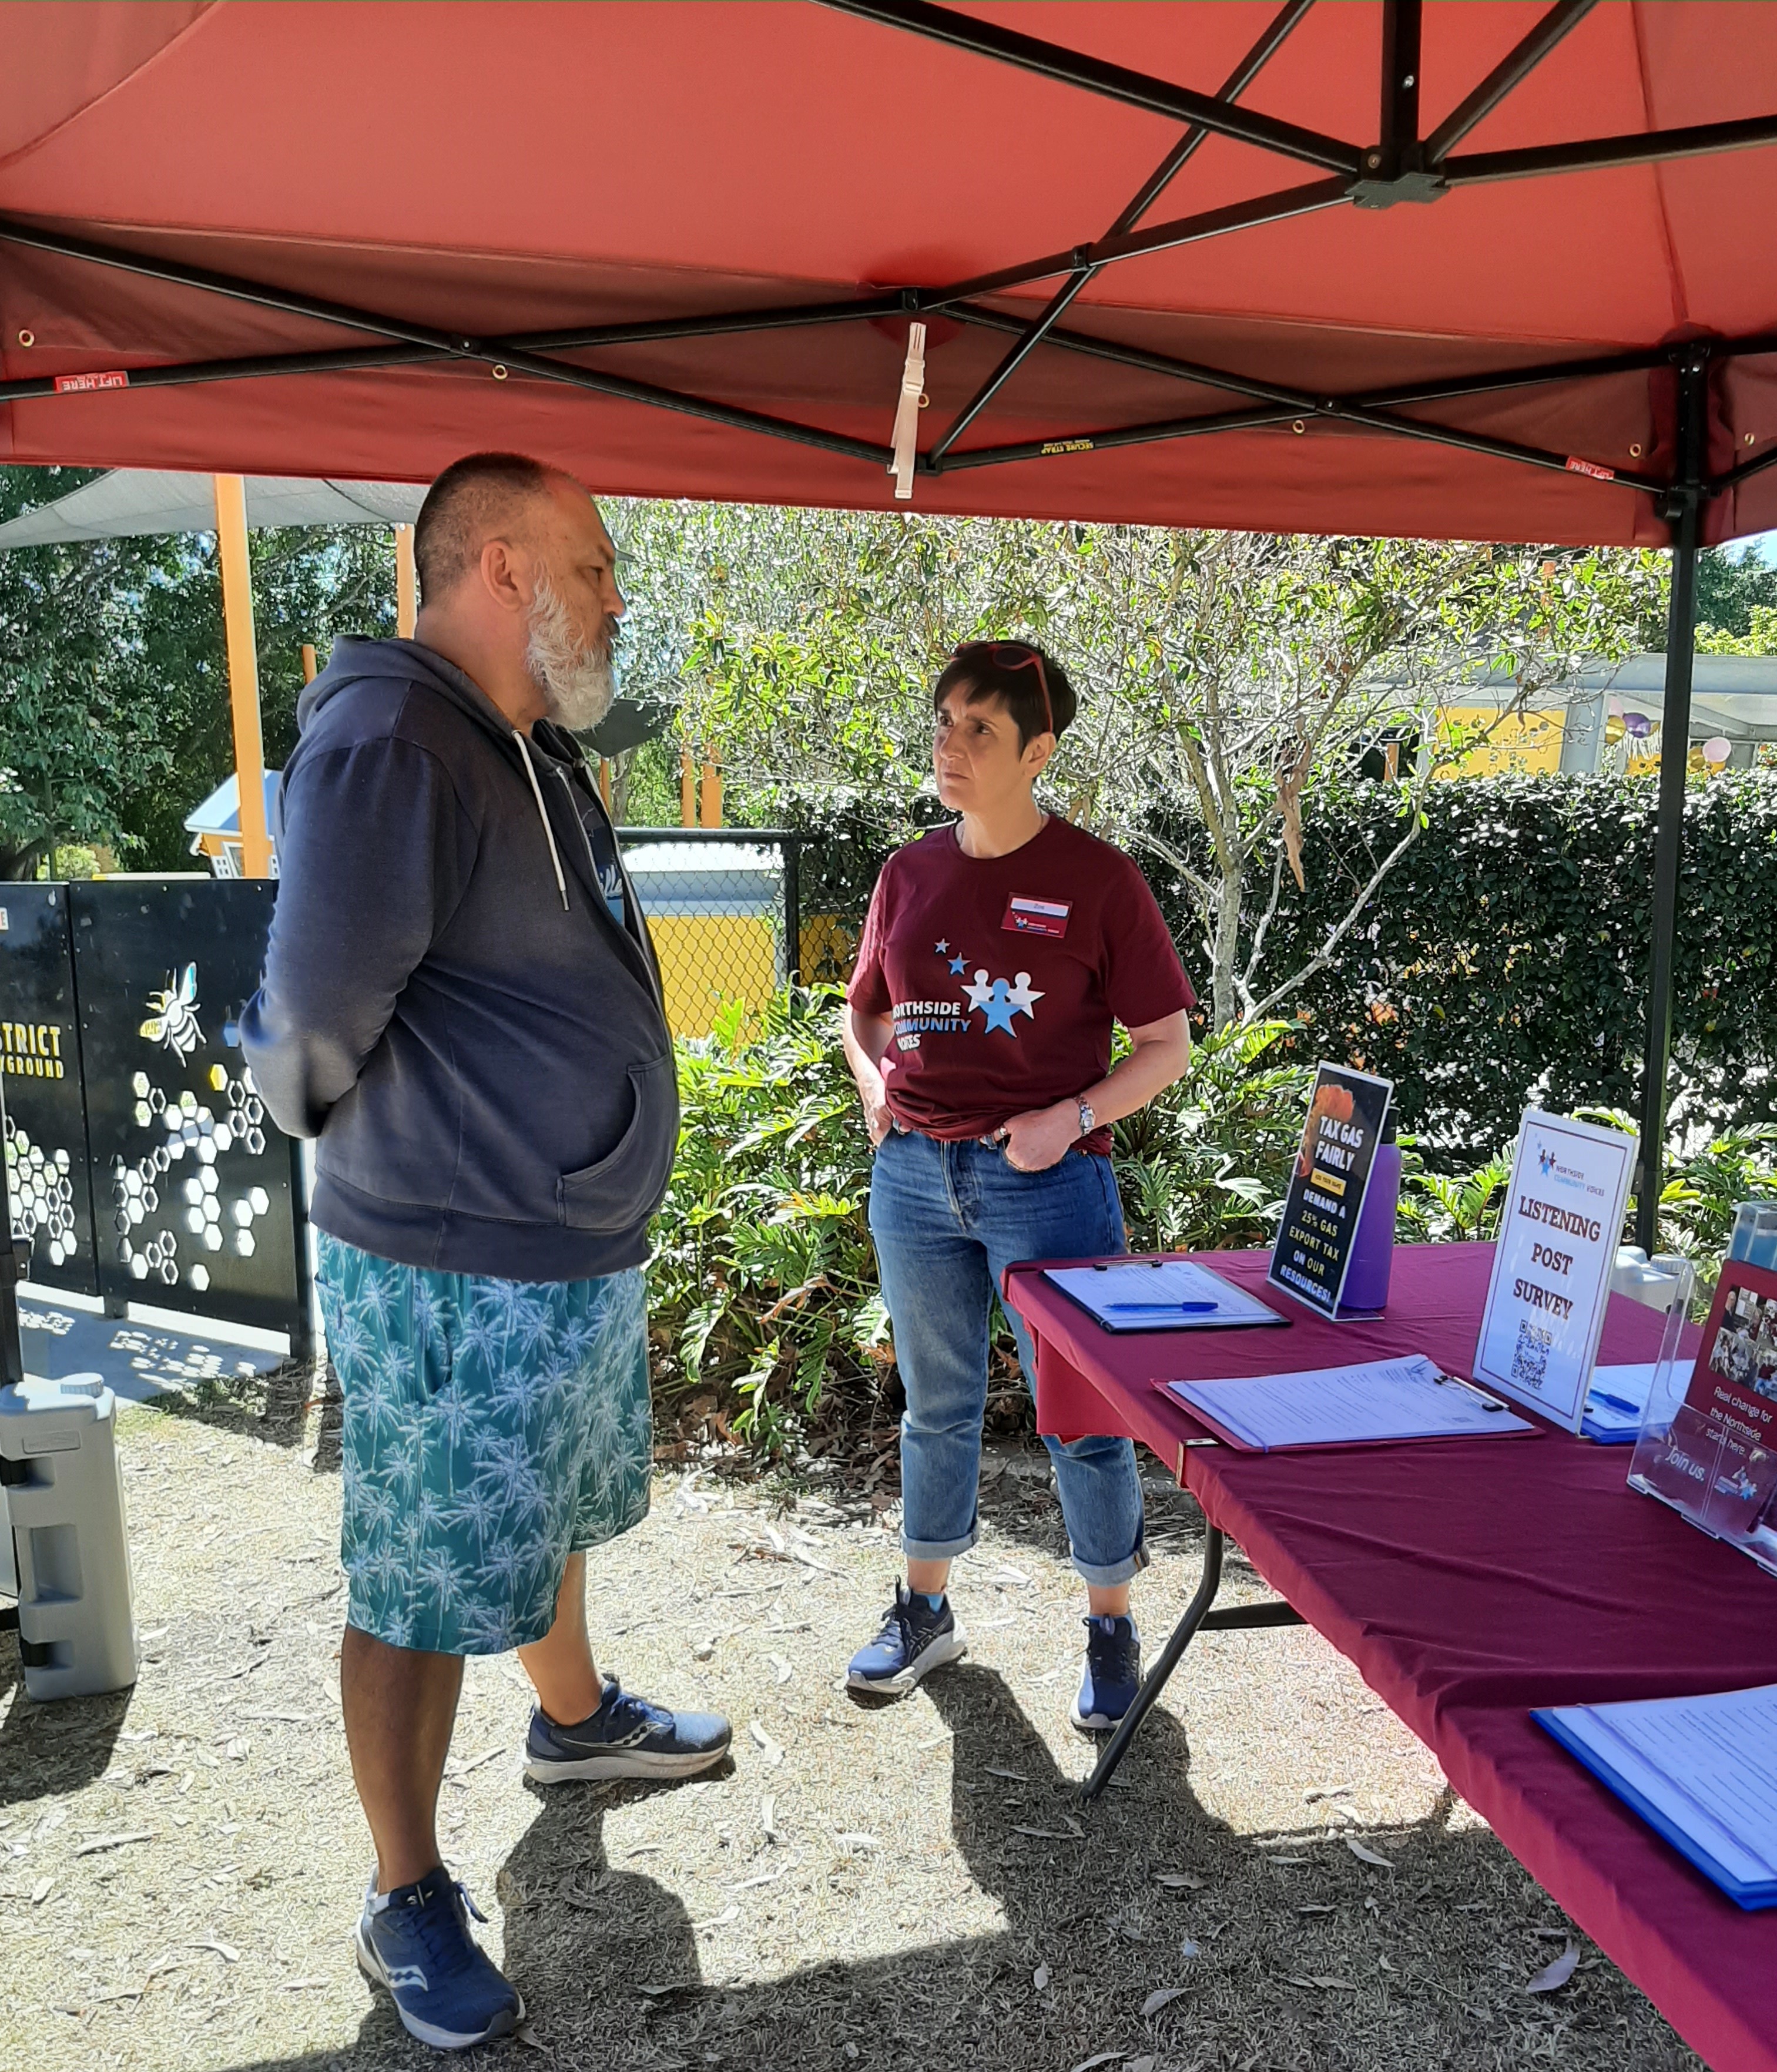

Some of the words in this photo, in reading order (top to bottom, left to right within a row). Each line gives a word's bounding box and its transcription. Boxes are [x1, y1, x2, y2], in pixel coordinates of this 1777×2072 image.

[62, 378, 96, 391] HERE
[98, 375, 123, 387] LIFT
[1569, 460, 1592, 475] HERE
[0, 1022, 61, 1057] TRICT
[1319, 1115, 1341, 1141] TAX
[1340, 1124, 1364, 1148] GAS
[1315, 1140, 1356, 1171] FAIRLY
[1303, 1188, 1338, 1214] DEMAND
[1338, 1205, 1346, 1219] A
[1518, 1195, 1601, 1242] LISTENING
[1301, 1209, 1319, 1228] 25%
[1320, 1219, 1339, 1237] GAS
[1289, 1225, 1321, 1250] EXPORT
[1323, 1242, 1340, 1262] TAX
[1530, 1242, 1574, 1275] POST
[1293, 1249, 1306, 1265] ON
[1307, 1258, 1325, 1276] OUR
[1280, 1264, 1332, 1303] RESOURCES!
[1513, 1278, 1574, 1320] SURVEY
[1714, 1386, 1732, 1404] Real
[1731, 1396, 1760, 1418] change
[1760, 1409, 1773, 1423] for
[1709, 1407, 1723, 1421] the
[1723, 1413, 1762, 1441] Northside
[1665, 1448, 1689, 1471] Join
[1688, 1463, 1705, 1481] us.
